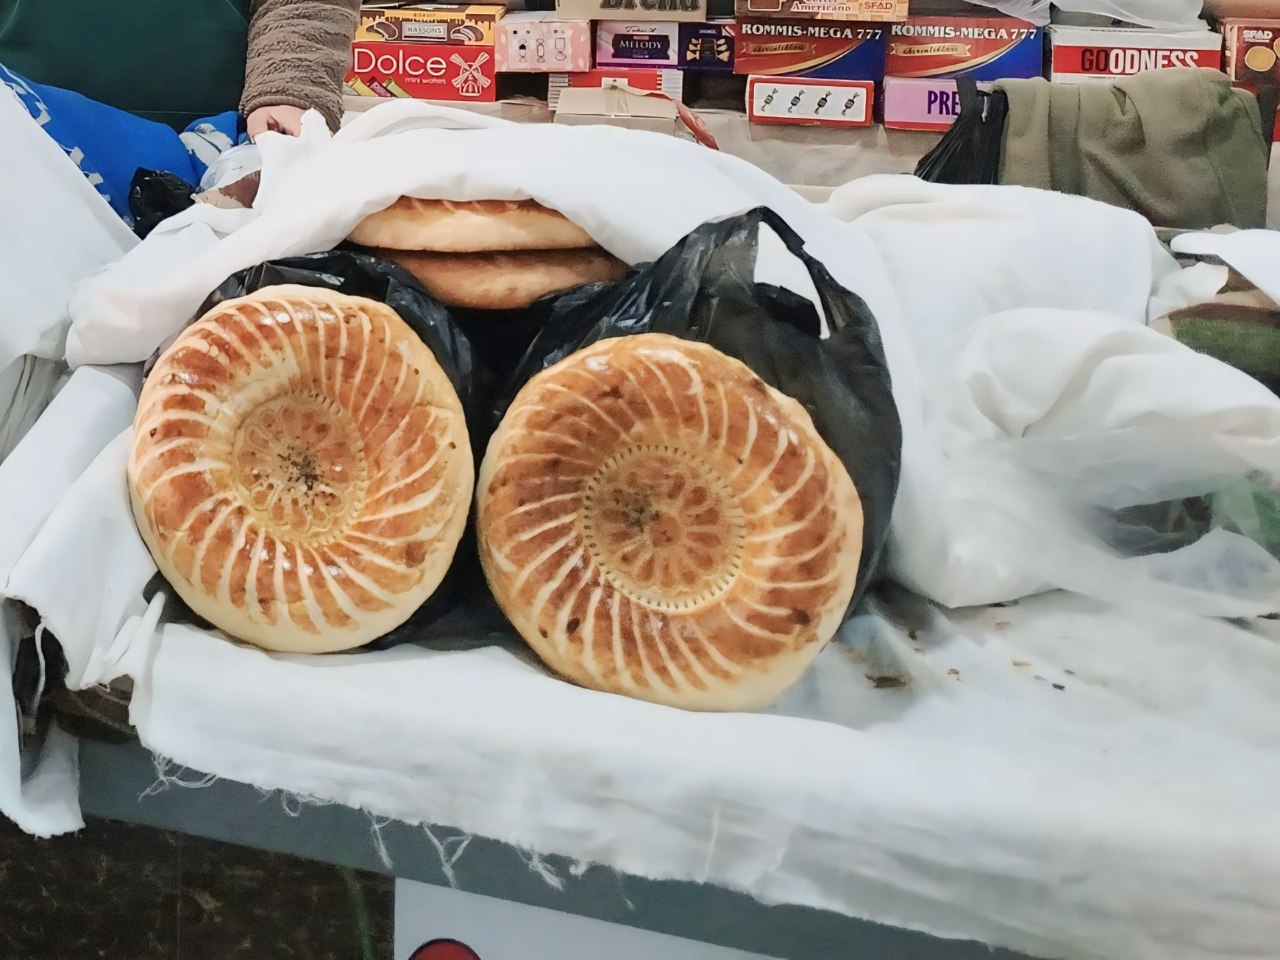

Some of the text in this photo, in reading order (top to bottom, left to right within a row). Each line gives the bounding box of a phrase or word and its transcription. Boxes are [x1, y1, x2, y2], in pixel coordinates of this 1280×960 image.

[790, 1, 851, 12] Americano
[741, 23, 883, 40] ROMMIS-MEGA 777
[891, 23, 1037, 40] ROMMIS-MEGA 777
[354, 48, 447, 76] Dolce
[1081, 48, 1199, 74] GOODNESS
